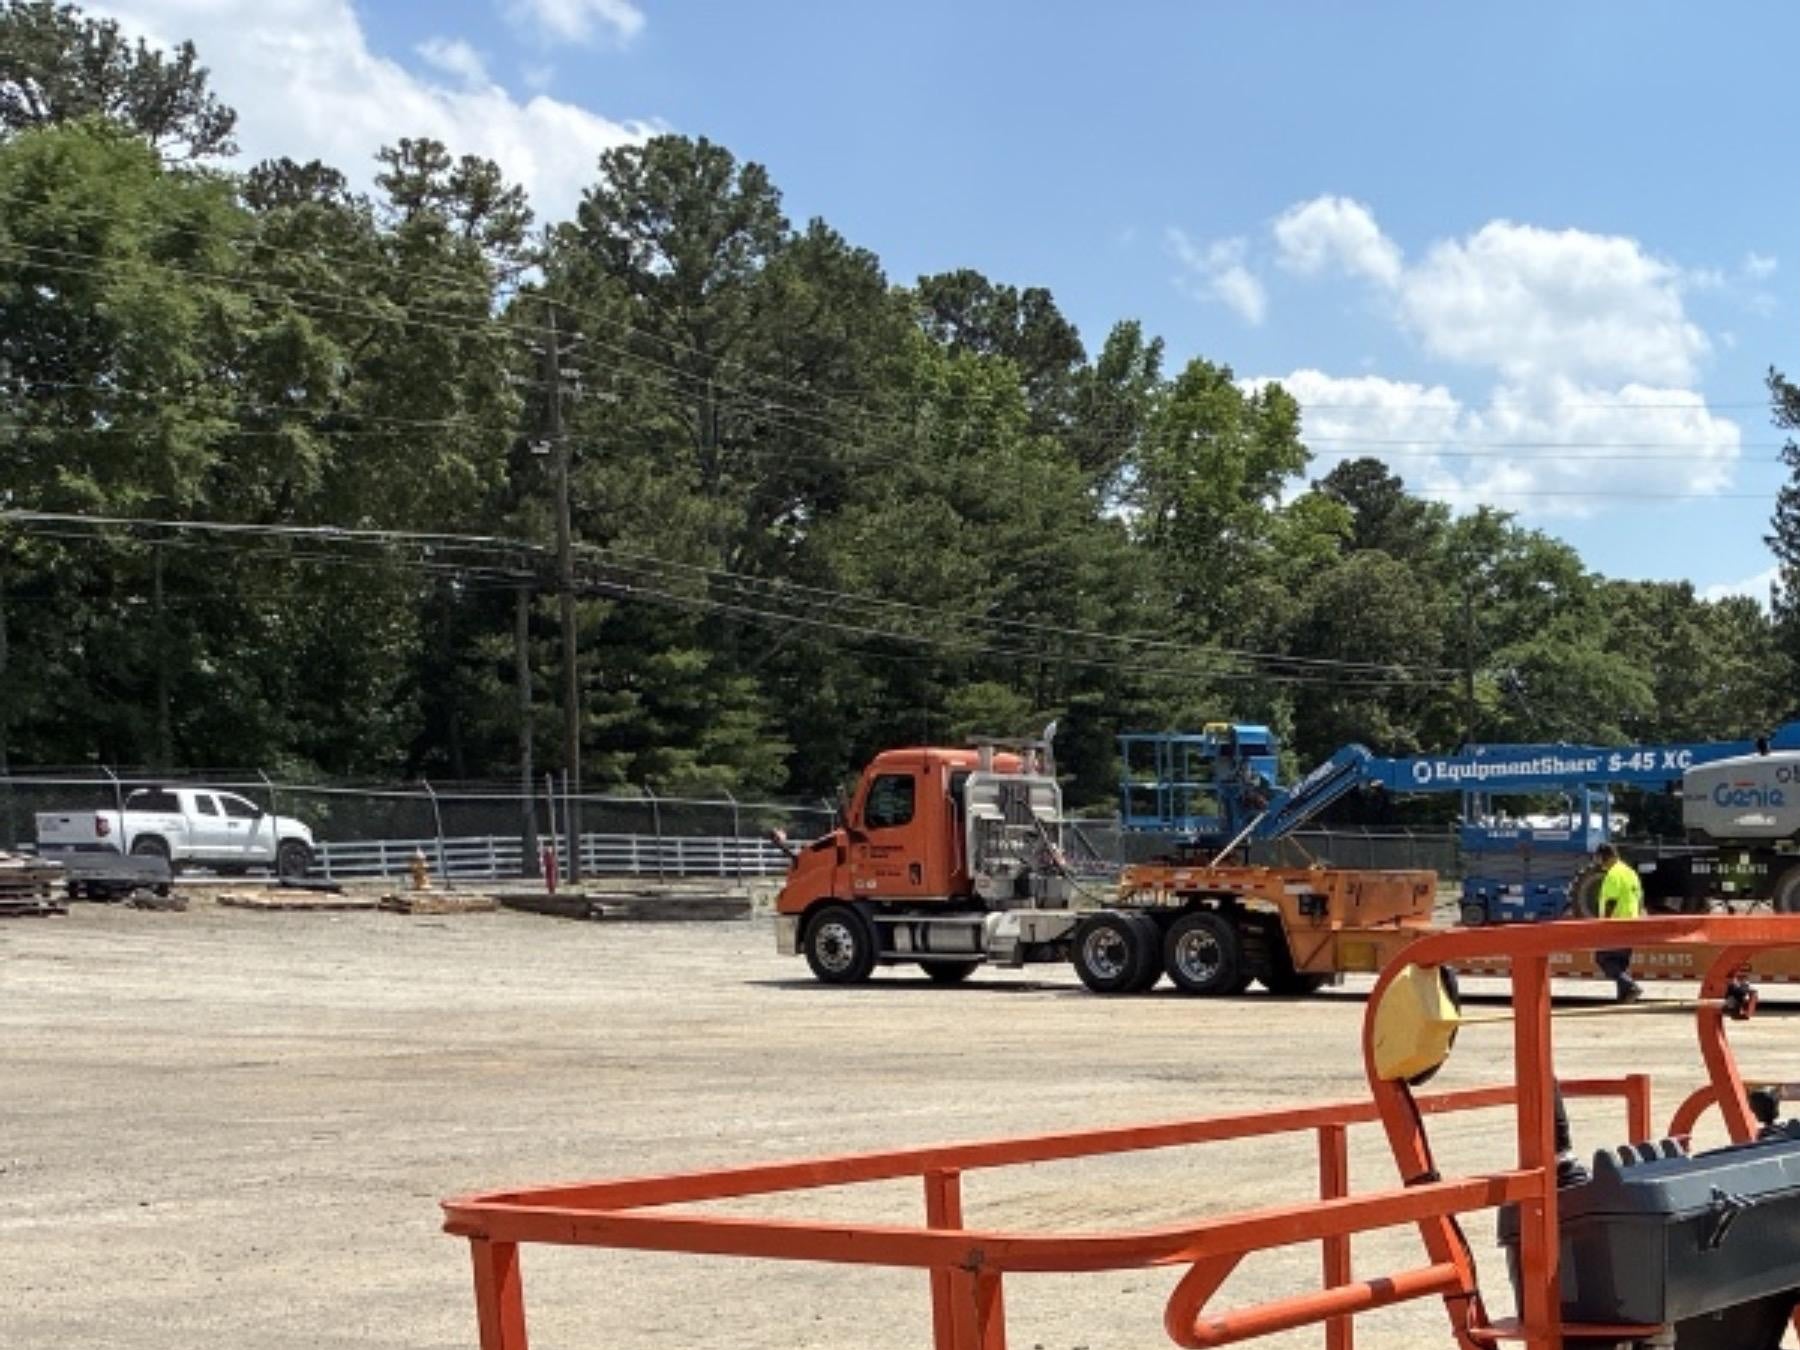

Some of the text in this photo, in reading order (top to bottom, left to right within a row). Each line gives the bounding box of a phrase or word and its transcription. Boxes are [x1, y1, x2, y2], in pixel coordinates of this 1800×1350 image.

[1607, 752, 1656, 772] S-45
[1662, 750, 1693, 769] XC
[1713, 781, 1785, 808] Genie
